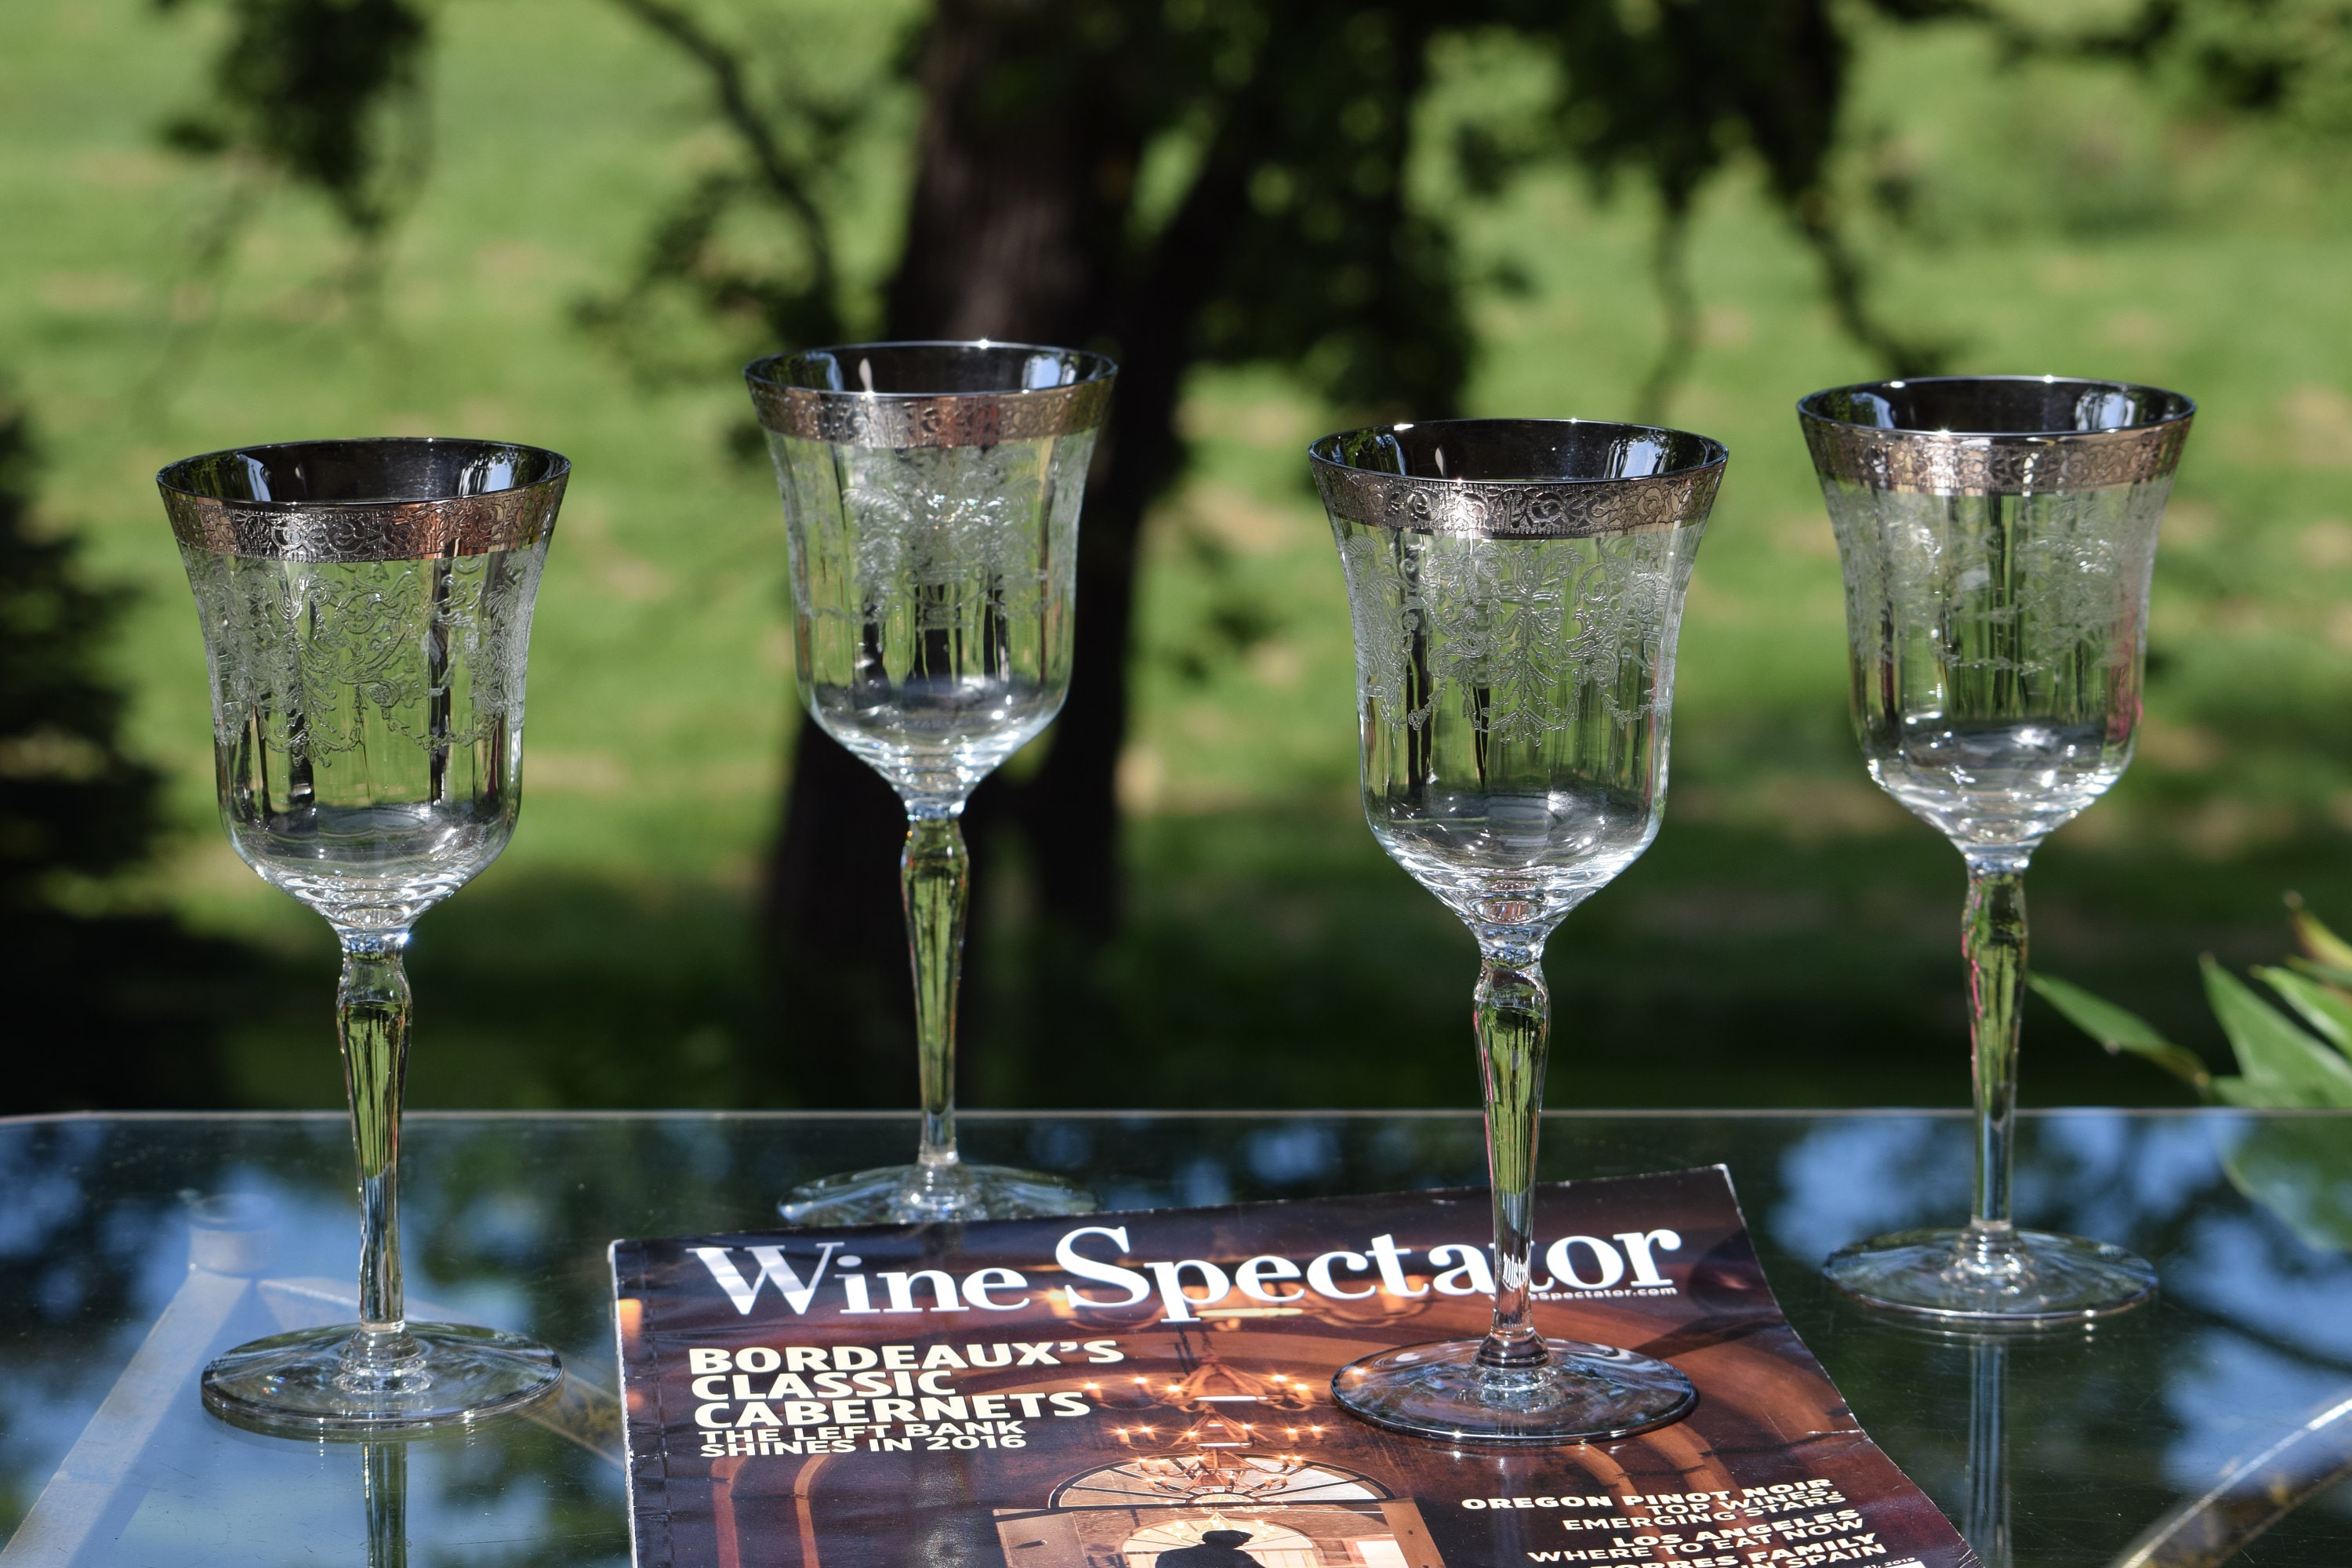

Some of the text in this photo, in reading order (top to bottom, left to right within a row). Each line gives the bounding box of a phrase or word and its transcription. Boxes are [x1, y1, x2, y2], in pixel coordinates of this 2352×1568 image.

[685, 1242, 1031, 1316] Wine
[1055, 1226, 1682, 1323] Spectaor
[688, 1340, 1124, 1374] BORDEAUX'S
[691, 1370, 956, 1402] CLASSIC
[694, 1392, 1091, 1428] CABERNETS
[698, 1421, 1026, 1443] THE LEFT BANK
[700, 1435, 1026, 1457] SHINES IN 2016
[1461, 1479, 1833, 1510] OREGON PINOT NOIR
[1645, 1503, 1710, 1515] TOP
[1562, 1494, 1846, 1530] EMERGING STARS
[1613, 1509, 1860, 1548] LOS ANGELES
[1527, 1518, 1864, 1563] WHERE TO EAT NOW
[1590, 1533, 1876, 1568] RRES FAMILY
[1784, 1544, 1887, 1568] SPAIN
[1884, 1557, 1915, 1566] 2019
